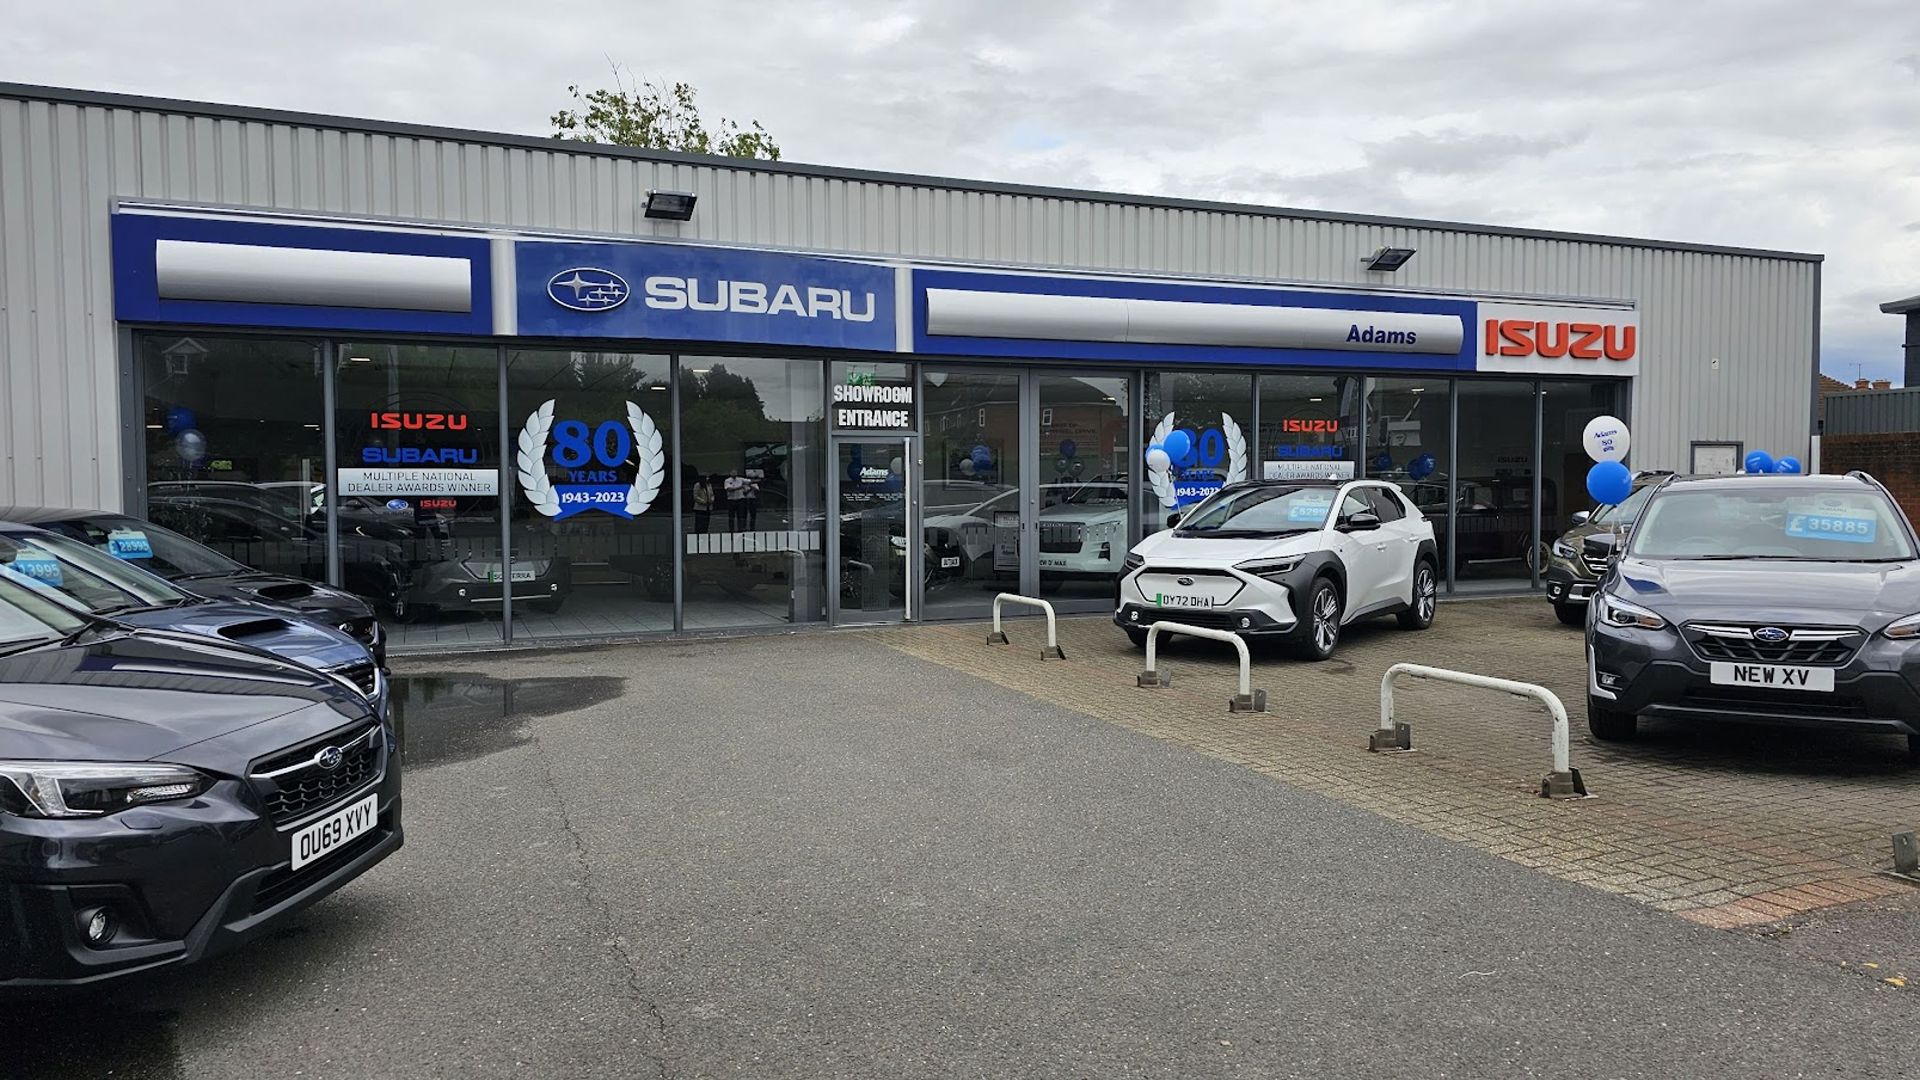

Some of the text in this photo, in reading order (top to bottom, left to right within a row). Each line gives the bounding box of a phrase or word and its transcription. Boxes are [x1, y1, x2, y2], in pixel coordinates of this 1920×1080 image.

[644, 276, 875, 323] SUBARU
[1345, 324, 1417, 345] Adams
[1485, 319, 1637, 361] ISUZU
[833, 384, 913, 404] SHOWROOM
[371, 412, 467, 430] ISUZU
[838, 408, 909, 427] ENTRANCE
[1282, 418, 1339, 433] ISUZU
[1594, 430, 1617, 439] Adams
[551, 419, 631, 468] 80
[1276, 444, 1344, 458] SUBARU
[362, 447, 478, 464] SUBARU
[362, 471, 476, 481] MULTIPLE NATIONAL
[568, 471, 617, 482] YEARS
[860, 467, 889, 476] Adams
[348, 482, 491, 493] DEALER AWARDS WINNER
[420, 499, 457, 509] ISUZU
[561, 491, 625, 503] 1943-2023
[1190, 596, 1210, 608] DHA
[1734, 665, 1810, 686] NEW XV
[300, 801, 371, 861] OU69 XVY
